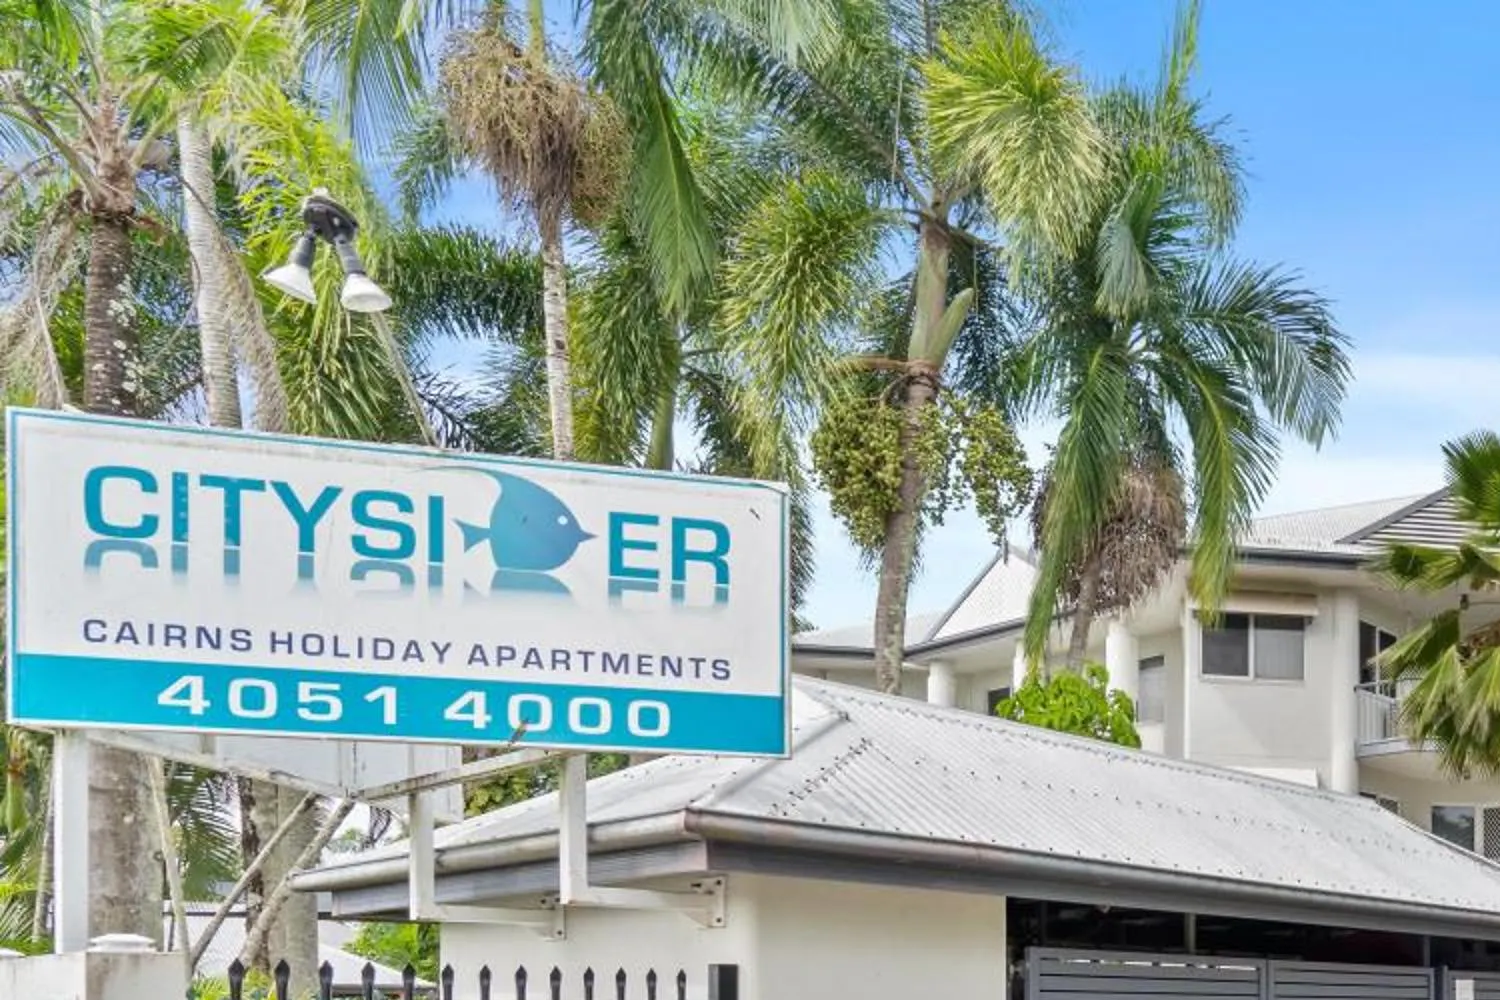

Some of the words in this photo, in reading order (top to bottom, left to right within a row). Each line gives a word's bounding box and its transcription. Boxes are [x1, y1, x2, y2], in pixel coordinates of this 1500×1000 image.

[83, 618, 253, 652] CAIRNS
[269, 630, 452, 664] HOLIDAY
[466, 642, 732, 681] APARTMENTS
[157, 674, 398, 725] 4051
[444, 690, 671, 738] 4000
